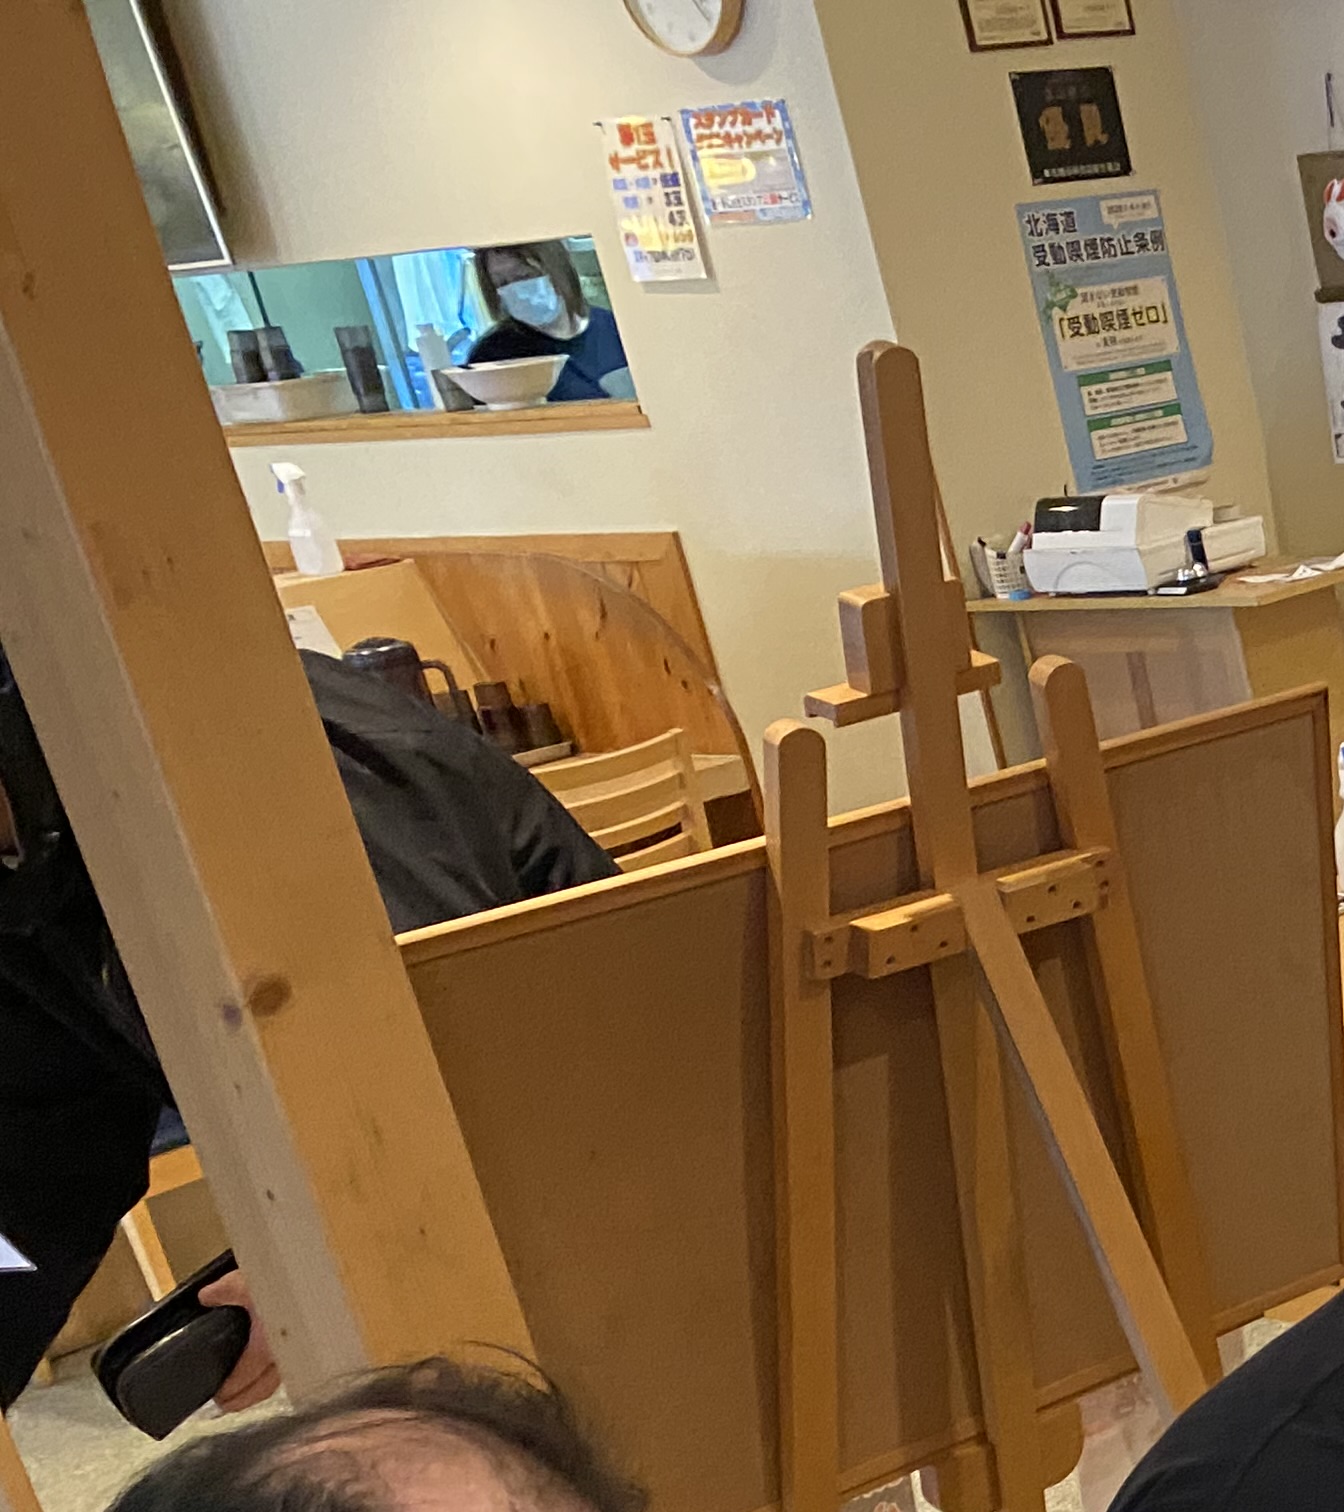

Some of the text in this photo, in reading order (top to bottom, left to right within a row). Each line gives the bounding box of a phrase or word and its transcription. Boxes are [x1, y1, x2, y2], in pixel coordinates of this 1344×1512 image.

[1025, 210, 1077, 238] 北海道
[1032, 229, 1165, 267] 受動喫煙防止条例
